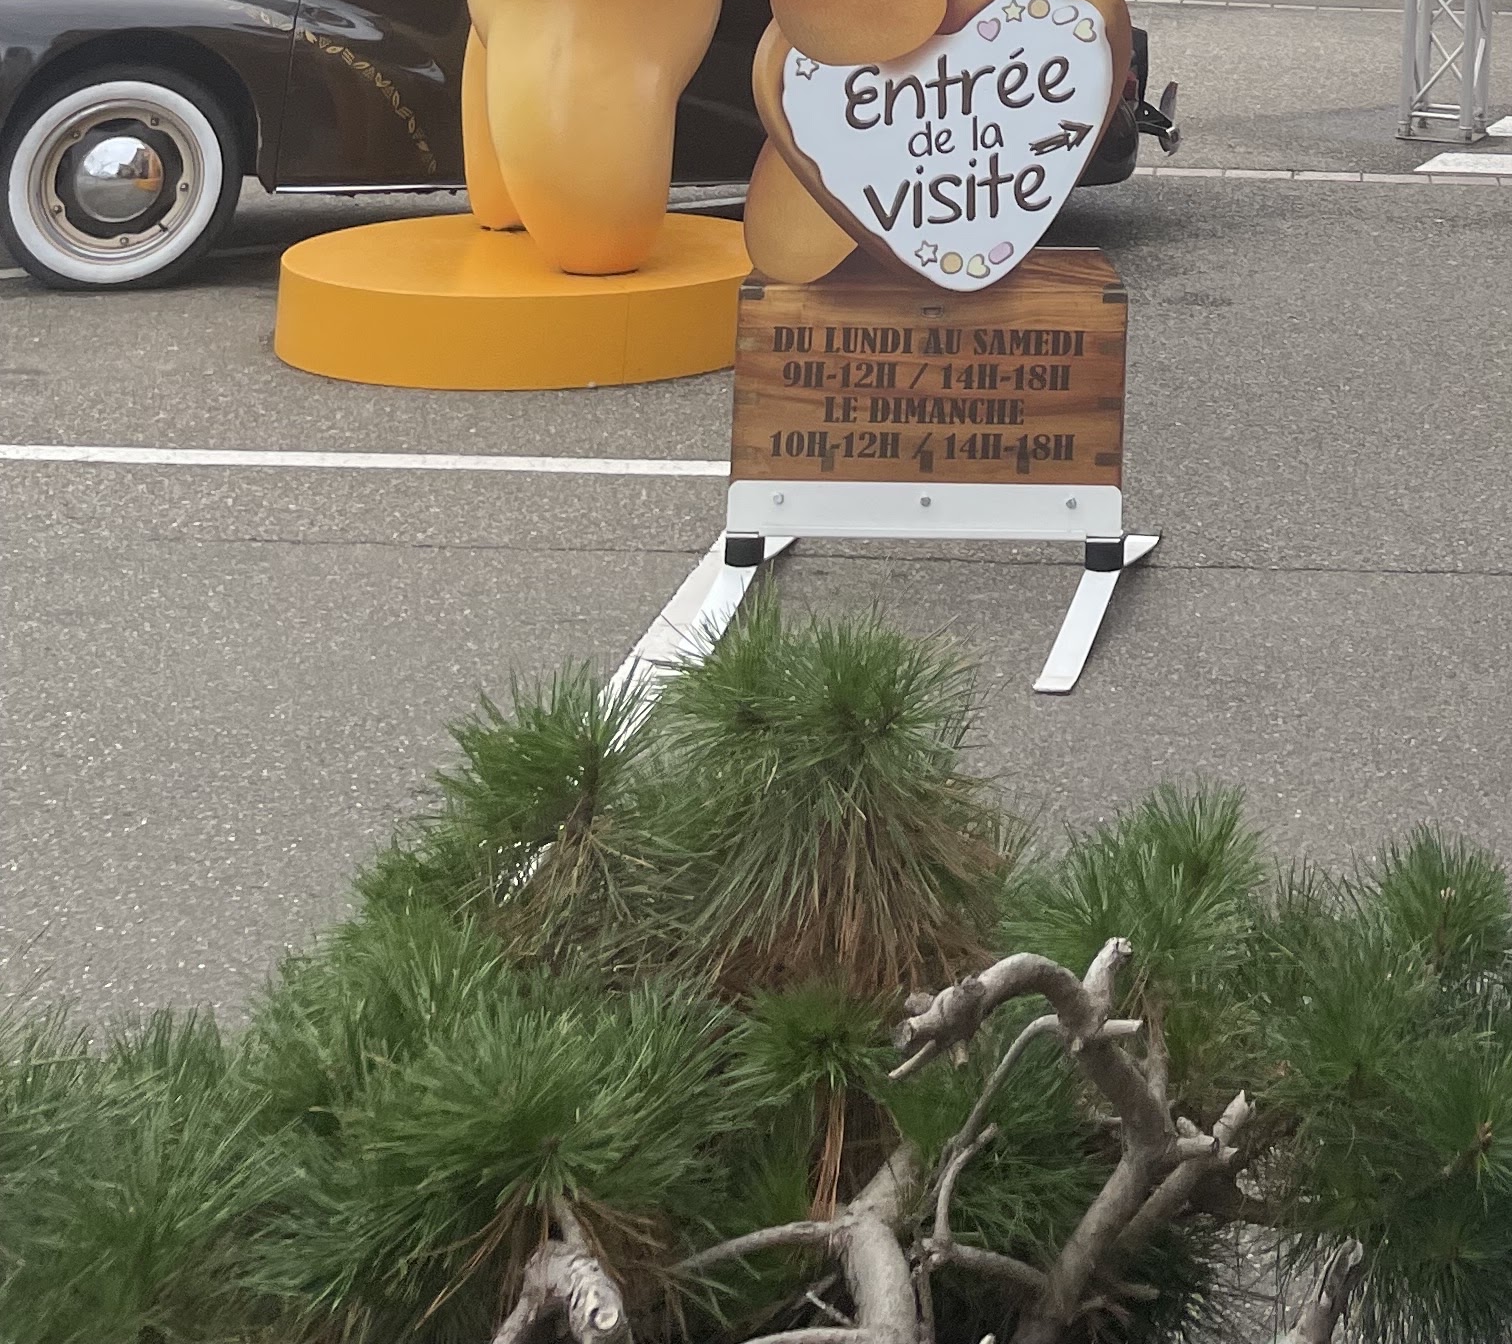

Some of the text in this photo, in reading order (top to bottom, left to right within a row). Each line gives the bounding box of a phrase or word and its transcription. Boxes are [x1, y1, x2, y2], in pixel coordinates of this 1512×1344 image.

[845, 47, 1075, 129] Entrée
[908, 115, 1004, 157] de la
[863, 152, 1052, 231] visite
[772, 326, 1085, 357] DU LUNDI AU SAMEDI
[782, 361, 897, 389] 9H-12H
[941, 364, 1071, 391] 14H-18H
[822, 396, 1025, 425] LE DIMANCHE
[770, 430, 901, 458] 10H-12H
[945, 432, 1075, 461] 14H-18H
